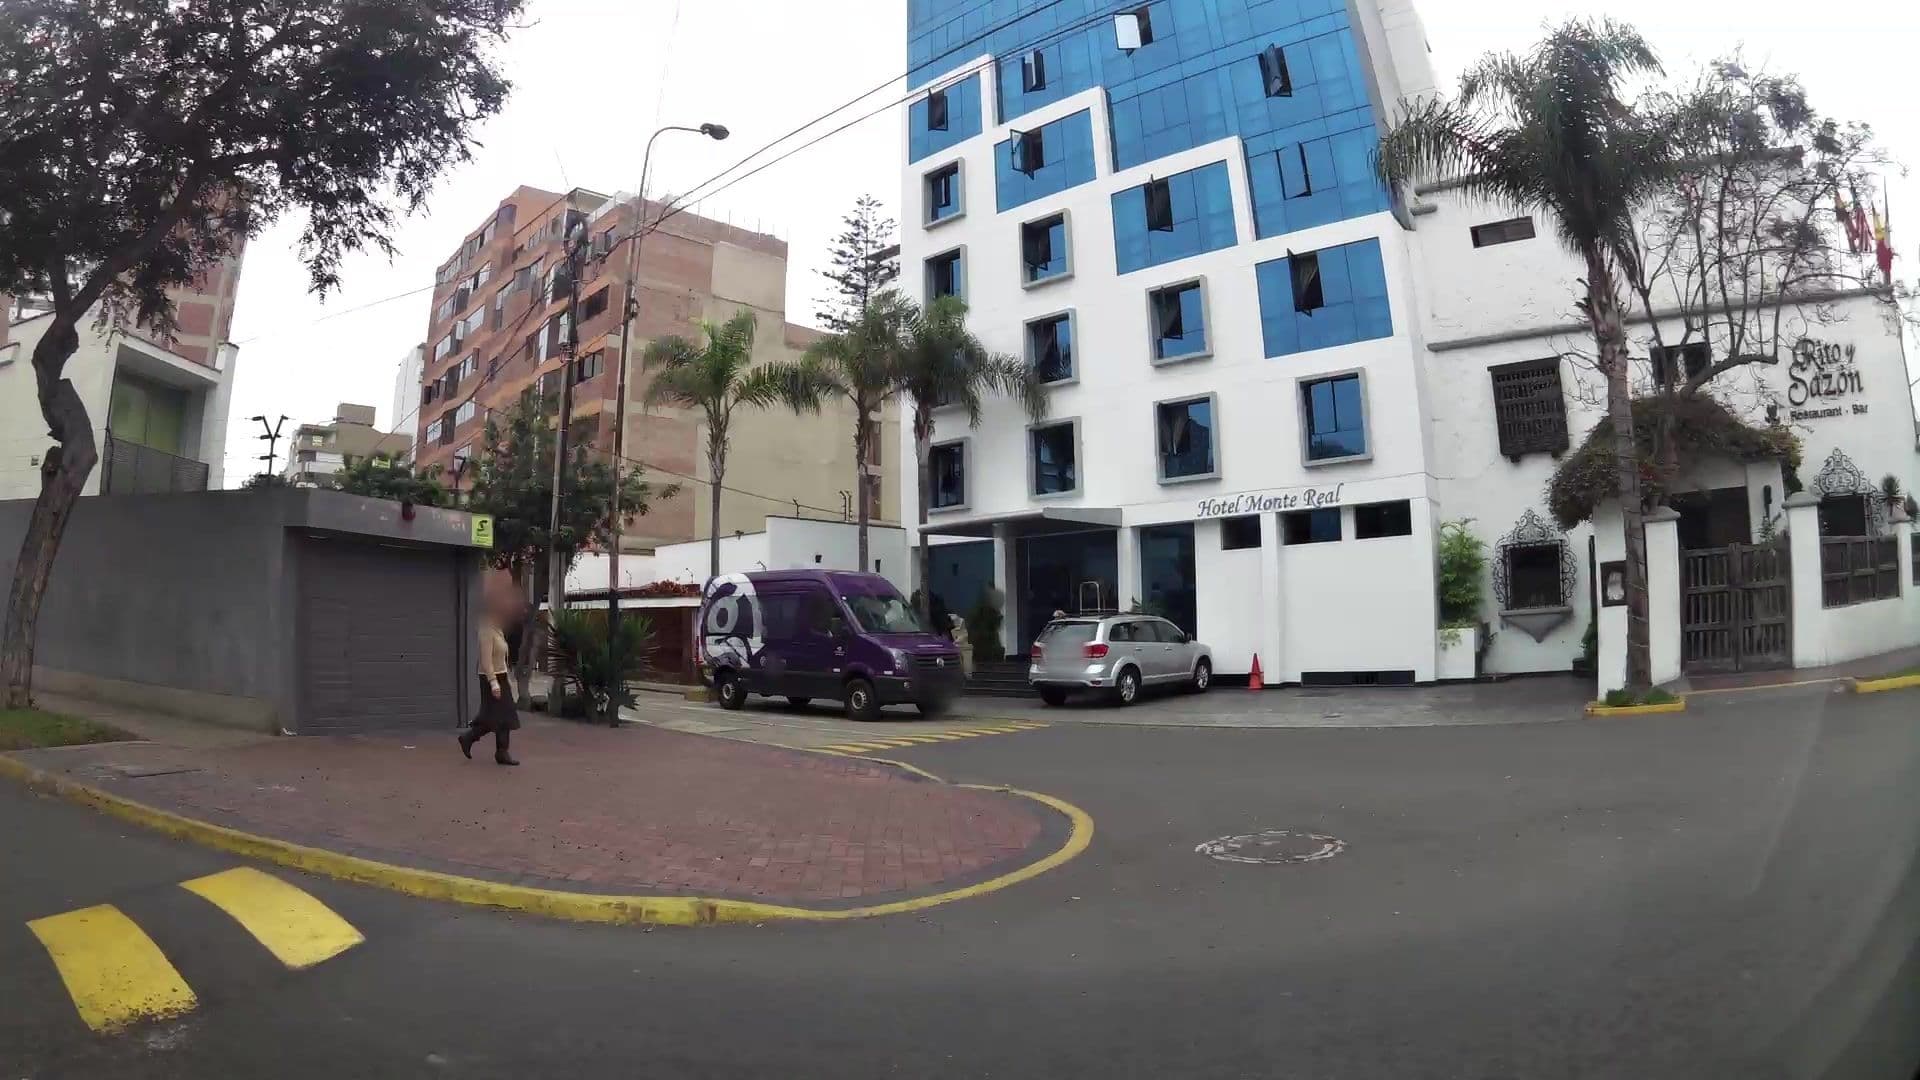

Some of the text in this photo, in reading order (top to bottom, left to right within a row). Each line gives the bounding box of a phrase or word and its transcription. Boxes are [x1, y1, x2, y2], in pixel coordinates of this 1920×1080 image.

[1791, 338, 1841, 371] Rito
[1788, 361, 1864, 406] Sazón
[1197, 482, 1344, 517] Hotel Monte Real
